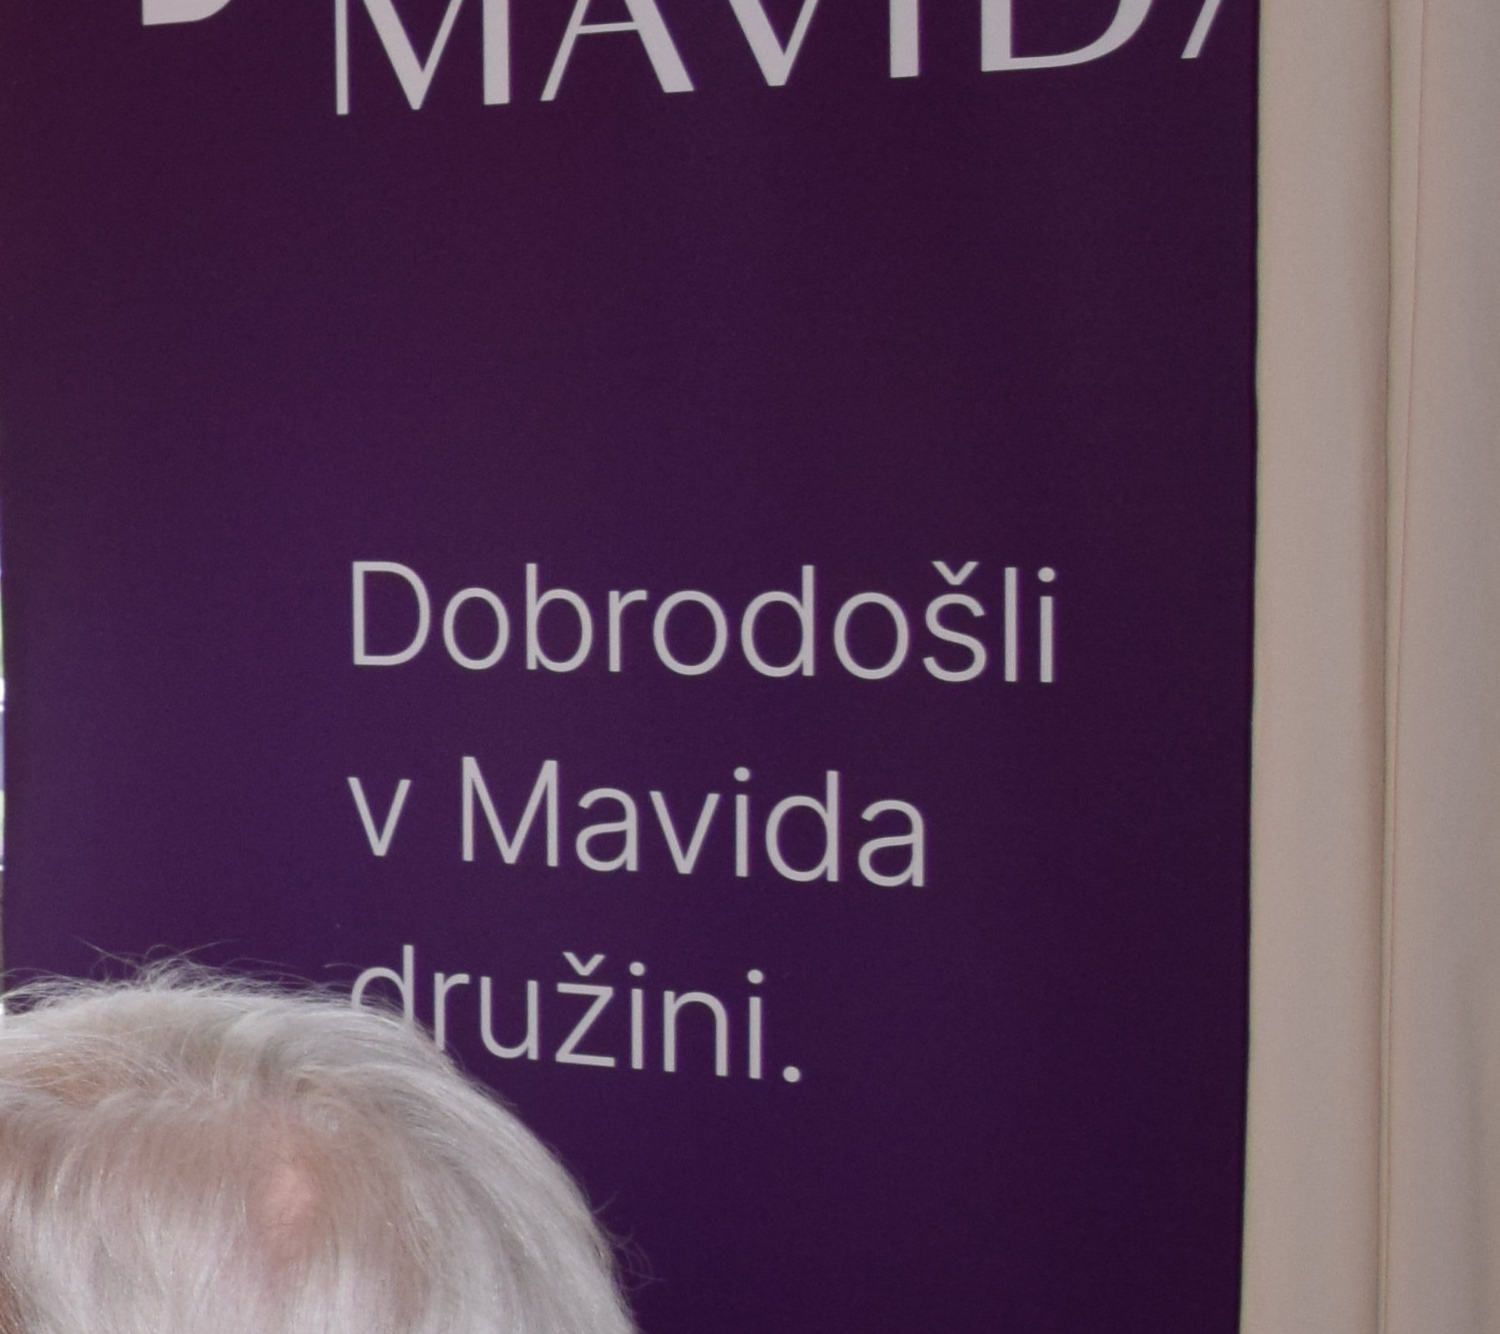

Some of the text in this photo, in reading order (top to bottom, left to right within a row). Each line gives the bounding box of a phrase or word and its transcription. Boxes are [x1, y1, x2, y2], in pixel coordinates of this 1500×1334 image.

[351, 560, 1058, 684] Dobrodošli
[348, 755, 928, 888] v Mavida
[351, 944, 803, 1085] družini.
